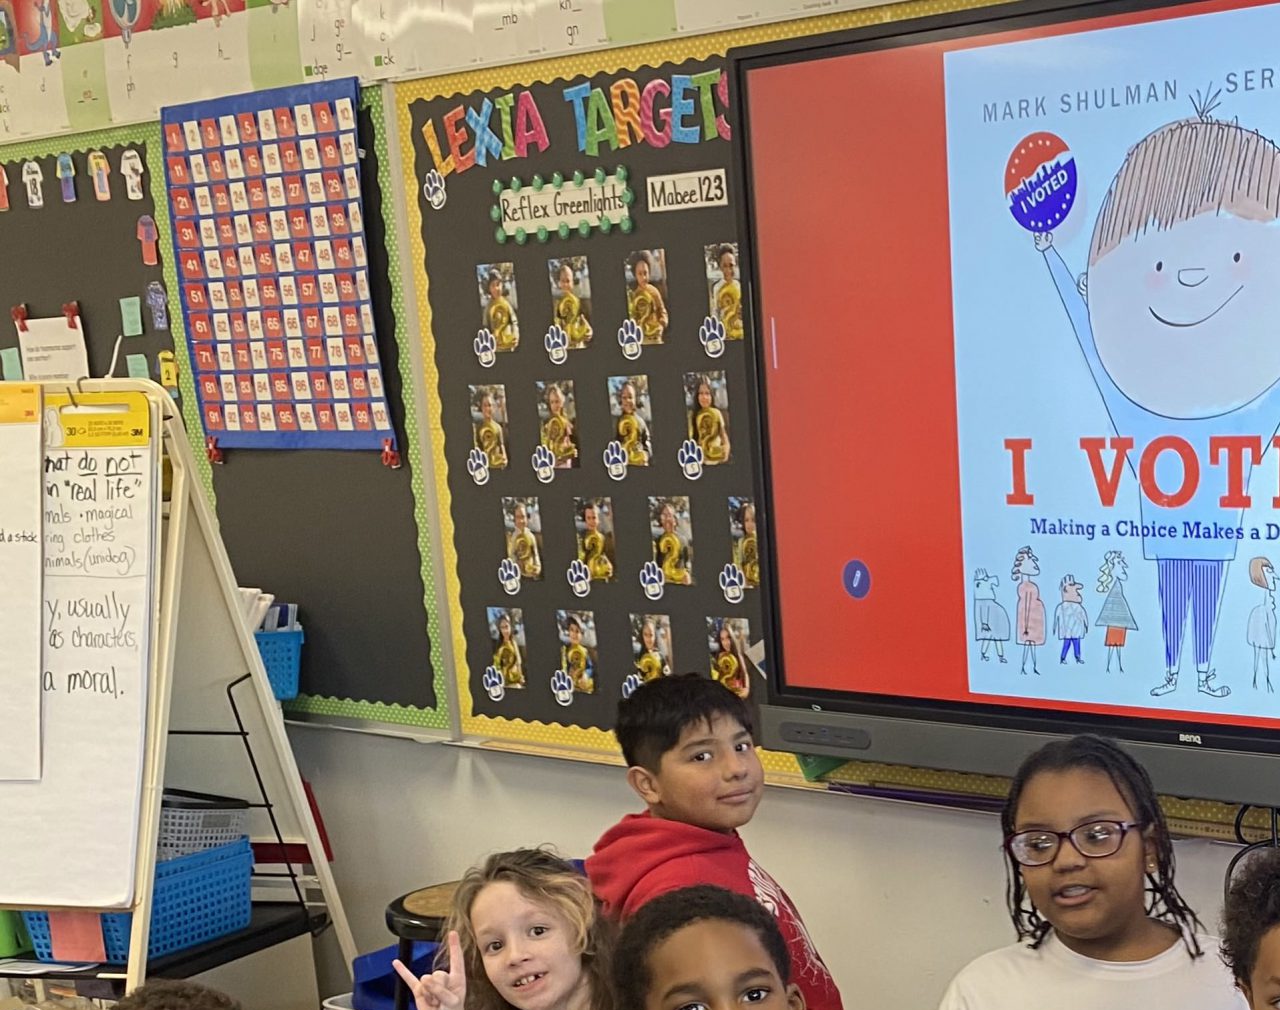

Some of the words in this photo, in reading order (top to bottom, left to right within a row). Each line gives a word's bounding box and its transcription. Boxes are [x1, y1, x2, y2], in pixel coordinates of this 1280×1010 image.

[983, 95, 1048, 123] MARK
[1060, 79, 1178, 114] SHULMAN
[281, 116, 288, 129] 7
[321, 112, 328, 124] 9
[421, 90, 550, 178] LEXIA
[286, 150, 294, 163] 17
[325, 145, 334, 158] 19
[173, 164, 182, 175] 11
[289, 184, 299, 196] 27
[1027, 167, 1069, 207] VOTED
[502, 198, 549, 223] Reflex
[554, 184, 624, 221] Greenlights
[294, 217, 304, 229] 37
[182, 228, 193, 240] 31
[298, 249, 310, 262] 47
[186, 259, 198, 271] 41
[190, 291, 202, 302] 51
[302, 284, 313, 296] 57
[267, 317, 280, 330] 65
[306, 316, 318, 328] 67
[200, 351, 212, 362] 71
[310, 346, 321, 358] 77
[315, 379, 326, 391] 87
[208, 412, 220, 423] 91
[357, 411, 368, 423] 99
[66, 427, 76, 436] 30
[130, 428, 143, 437] 3M
[78, 451, 98, 471] do
[105, 451, 142, 472] not
[1003, 438, 1034, 505] I
[47, 480, 60, 498] in
[73, 527, 115, 544] clothes
[1030, 518, 1096, 540] Making
[1101, 524, 1111, 537] a
[1116, 520, 1177, 538] Choice
[1182, 521, 1244, 540] Makes
[1250, 528, 1261, 540] a
[67, 591, 130, 632] usually
[49, 628, 64, 647] as
[43, 670, 56, 691] a
[67, 666, 124, 698] moral.
